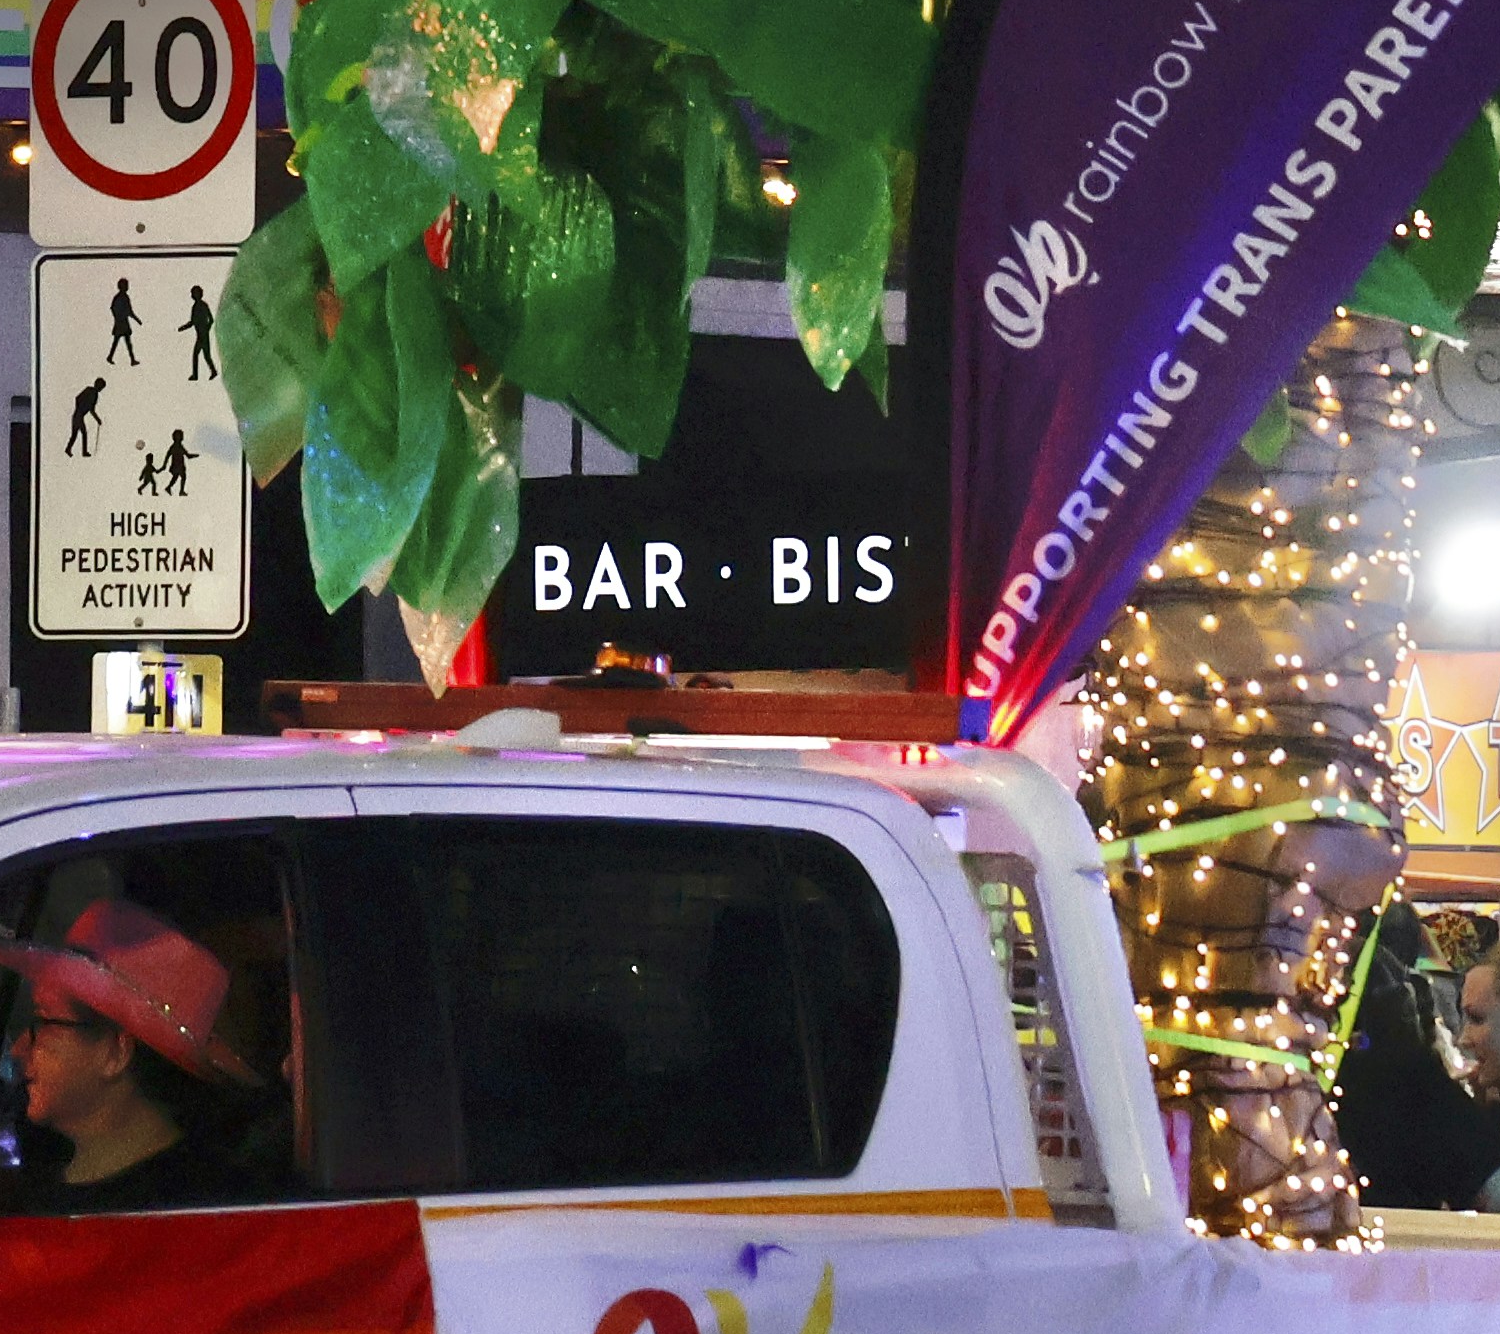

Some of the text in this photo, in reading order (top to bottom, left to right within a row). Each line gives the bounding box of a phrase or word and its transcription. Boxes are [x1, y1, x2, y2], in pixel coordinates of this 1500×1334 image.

[67, 17, 219, 125] 40
[1064, 3, 1218, 222] rainbow
[964, 351, 1200, 699] UPPORTING
[1178, 148, 1338, 345] TRANS
[61, 548, 214, 573] PEDESTRIAN
[110, 512, 166, 537] HIGH
[82, 583, 192, 609] ACTIVITY
[534, 534, 909, 612] BAR BIS
